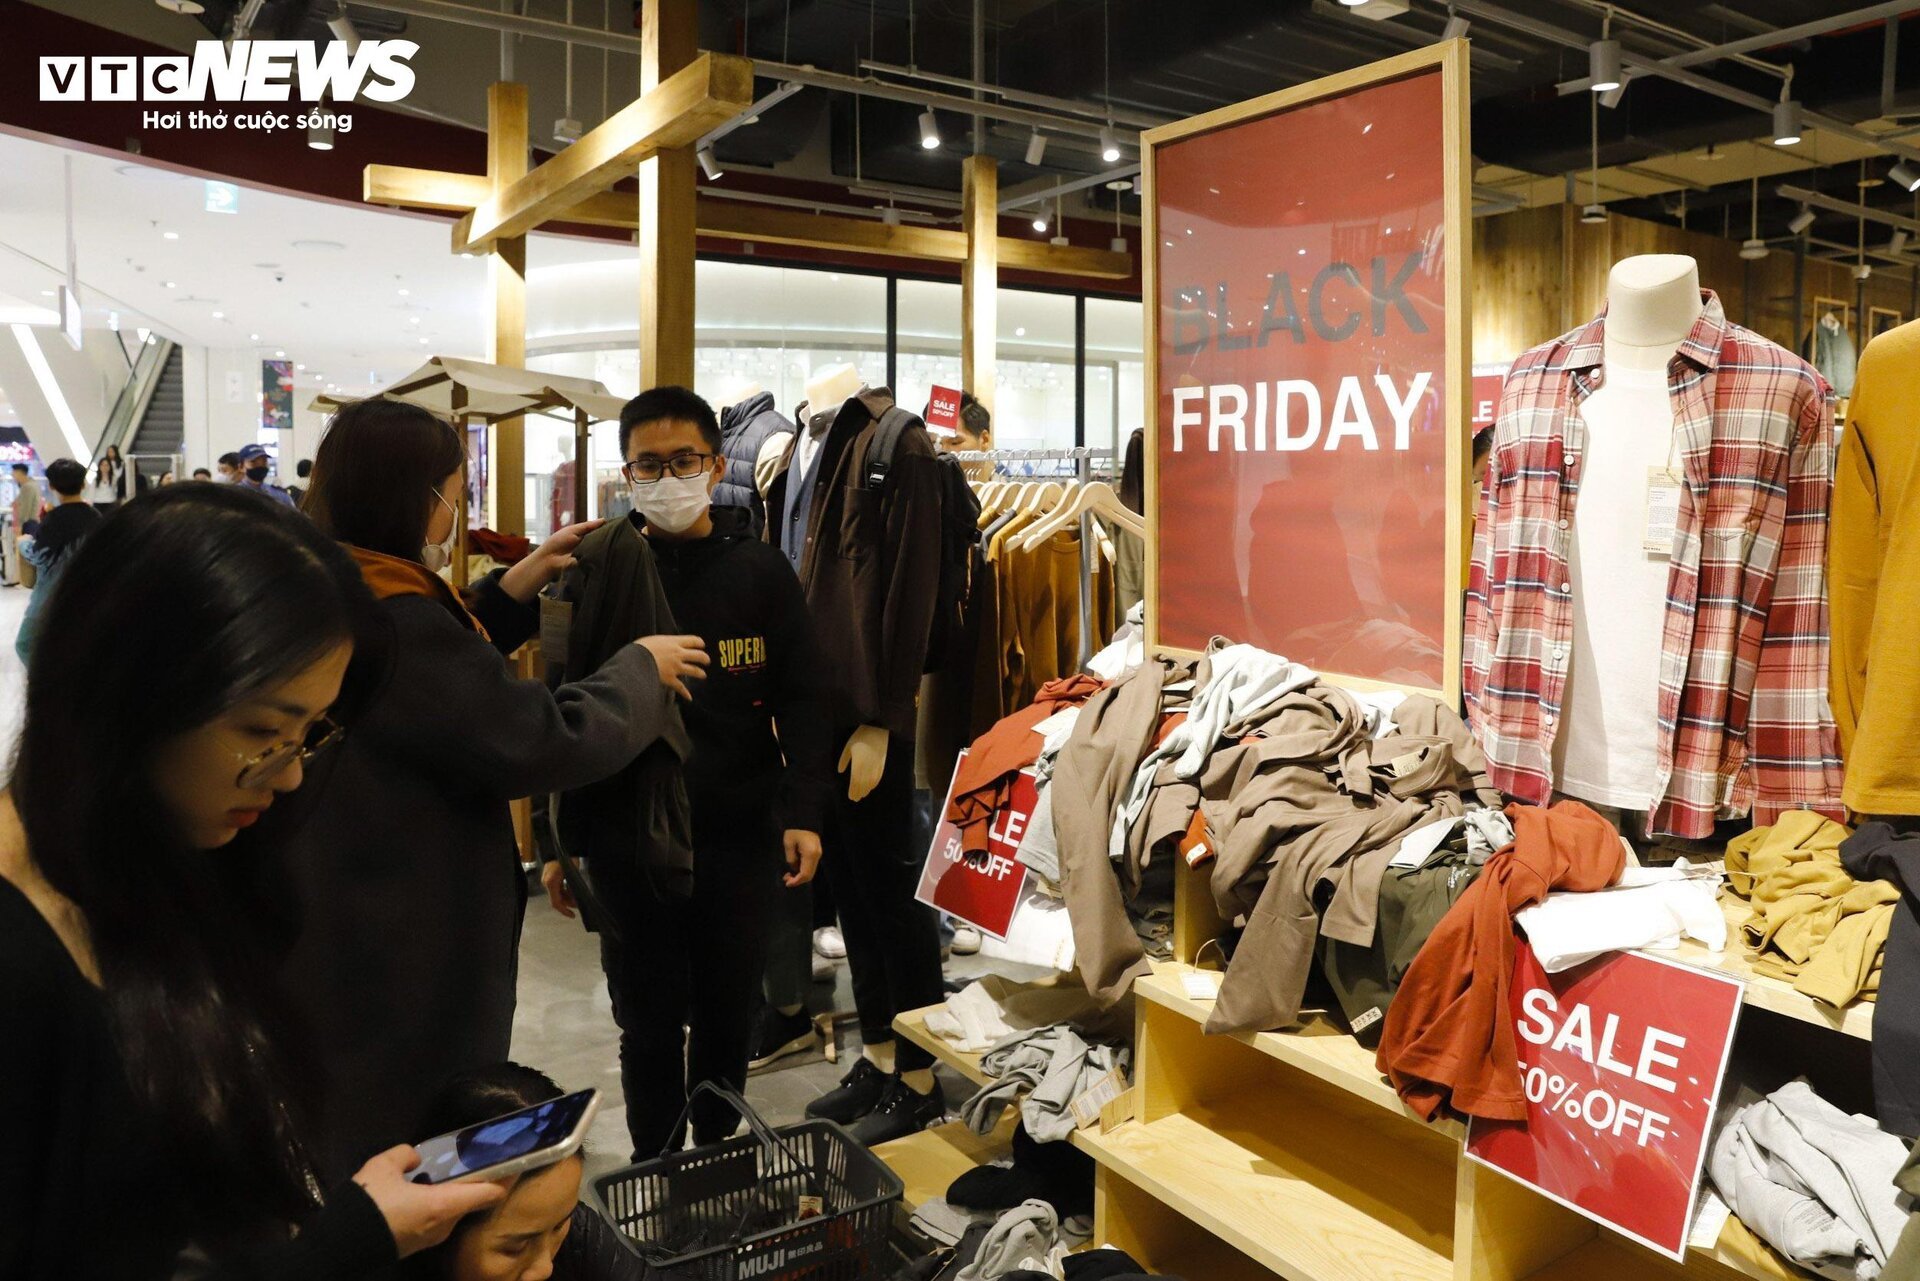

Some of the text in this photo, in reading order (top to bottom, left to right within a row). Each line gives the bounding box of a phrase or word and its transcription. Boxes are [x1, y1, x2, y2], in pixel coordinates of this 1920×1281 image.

[1173, 251, 1429, 355] BLACK
[933, 399, 955, 412] SALE
[1173, 371, 1433, 452] FRIDAY
[1517, 988, 1686, 1094] SALE
[738, 1249, 785, 1281] MUJI
